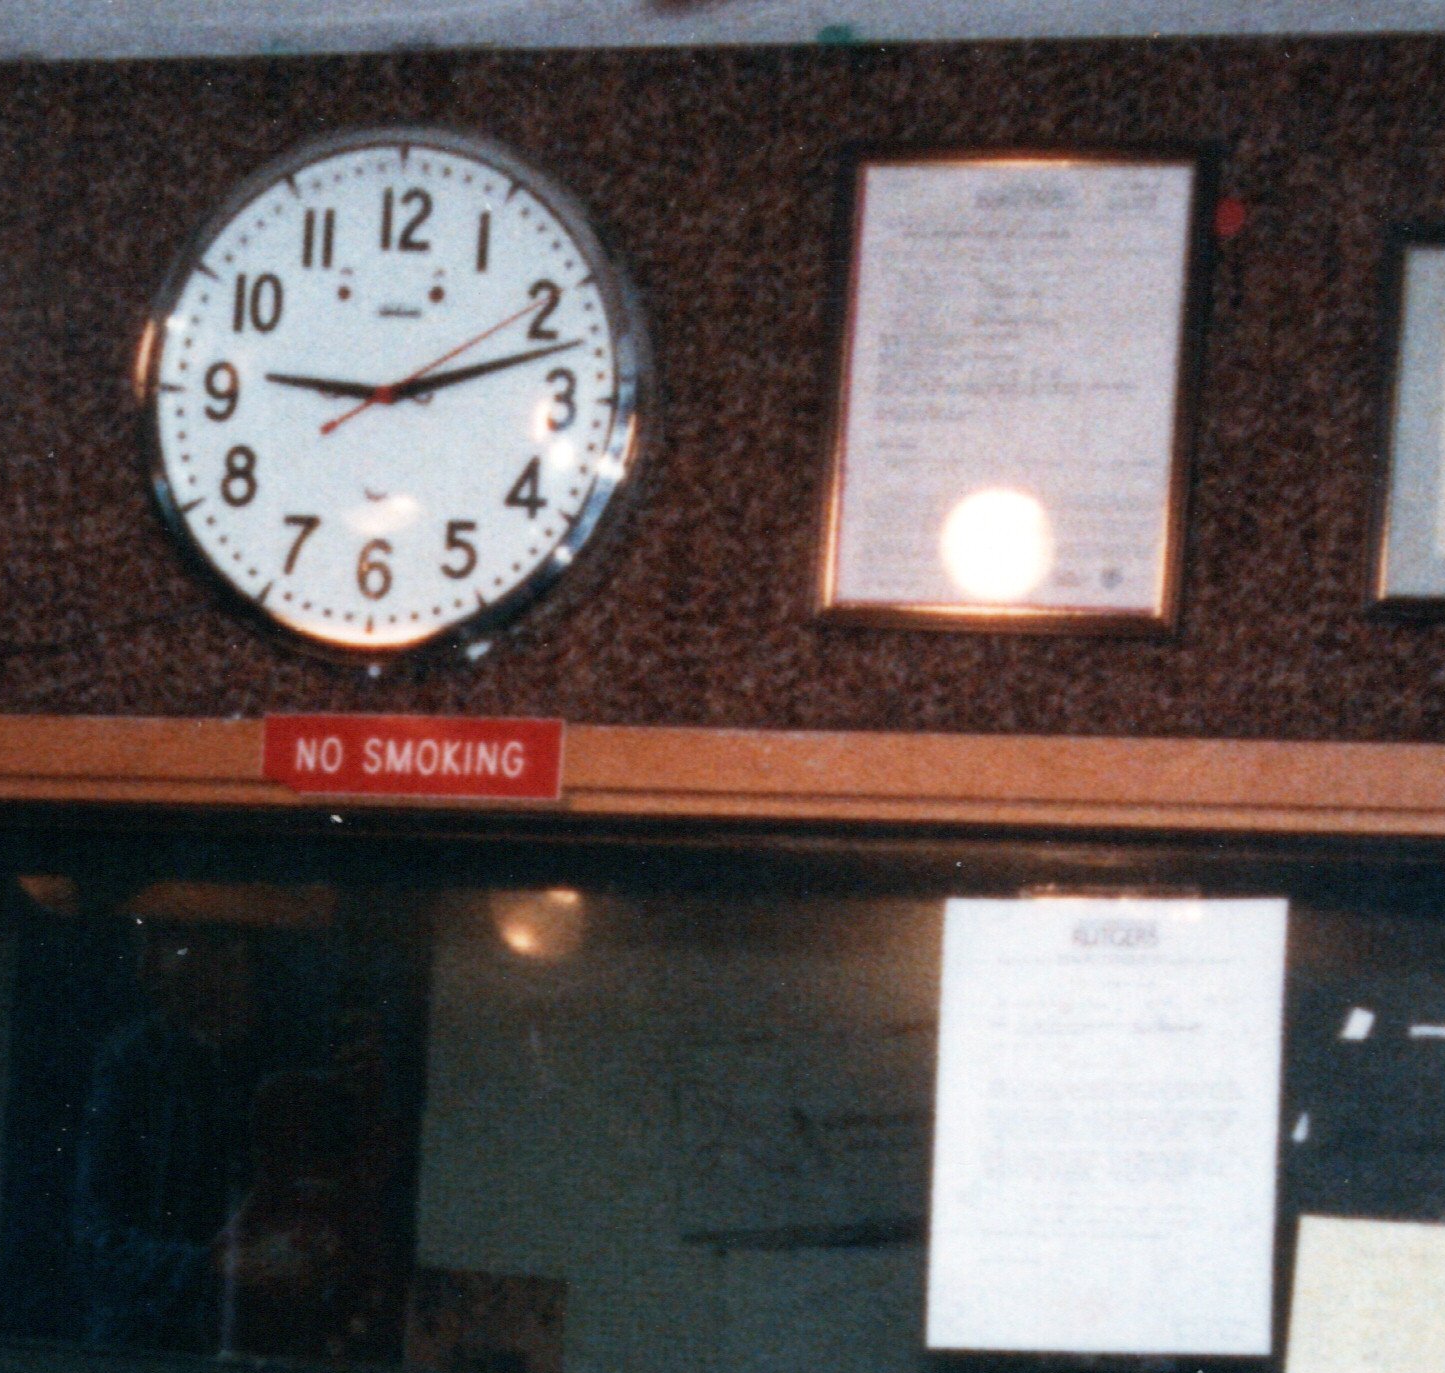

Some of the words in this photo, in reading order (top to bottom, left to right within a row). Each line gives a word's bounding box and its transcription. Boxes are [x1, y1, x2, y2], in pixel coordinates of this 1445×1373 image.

[301, 207, 336, 269] 11
[380, 186, 434, 253] 12
[475, 210, 491, 273] 1
[231, 273, 285, 334] 10
[527, 278, 562, 340] 2
[203, 361, 240, 422] 9
[544, 367, 577, 431] 3
[220, 445, 258, 507] 8
[504, 456, 547, 519] 4
[283, 515, 321, 575] 7
[356, 539, 393, 600] 6
[440, 521, 477, 580] 5
[296, 737, 343, 774] NO
[363, 737, 525, 779] SMOKING
